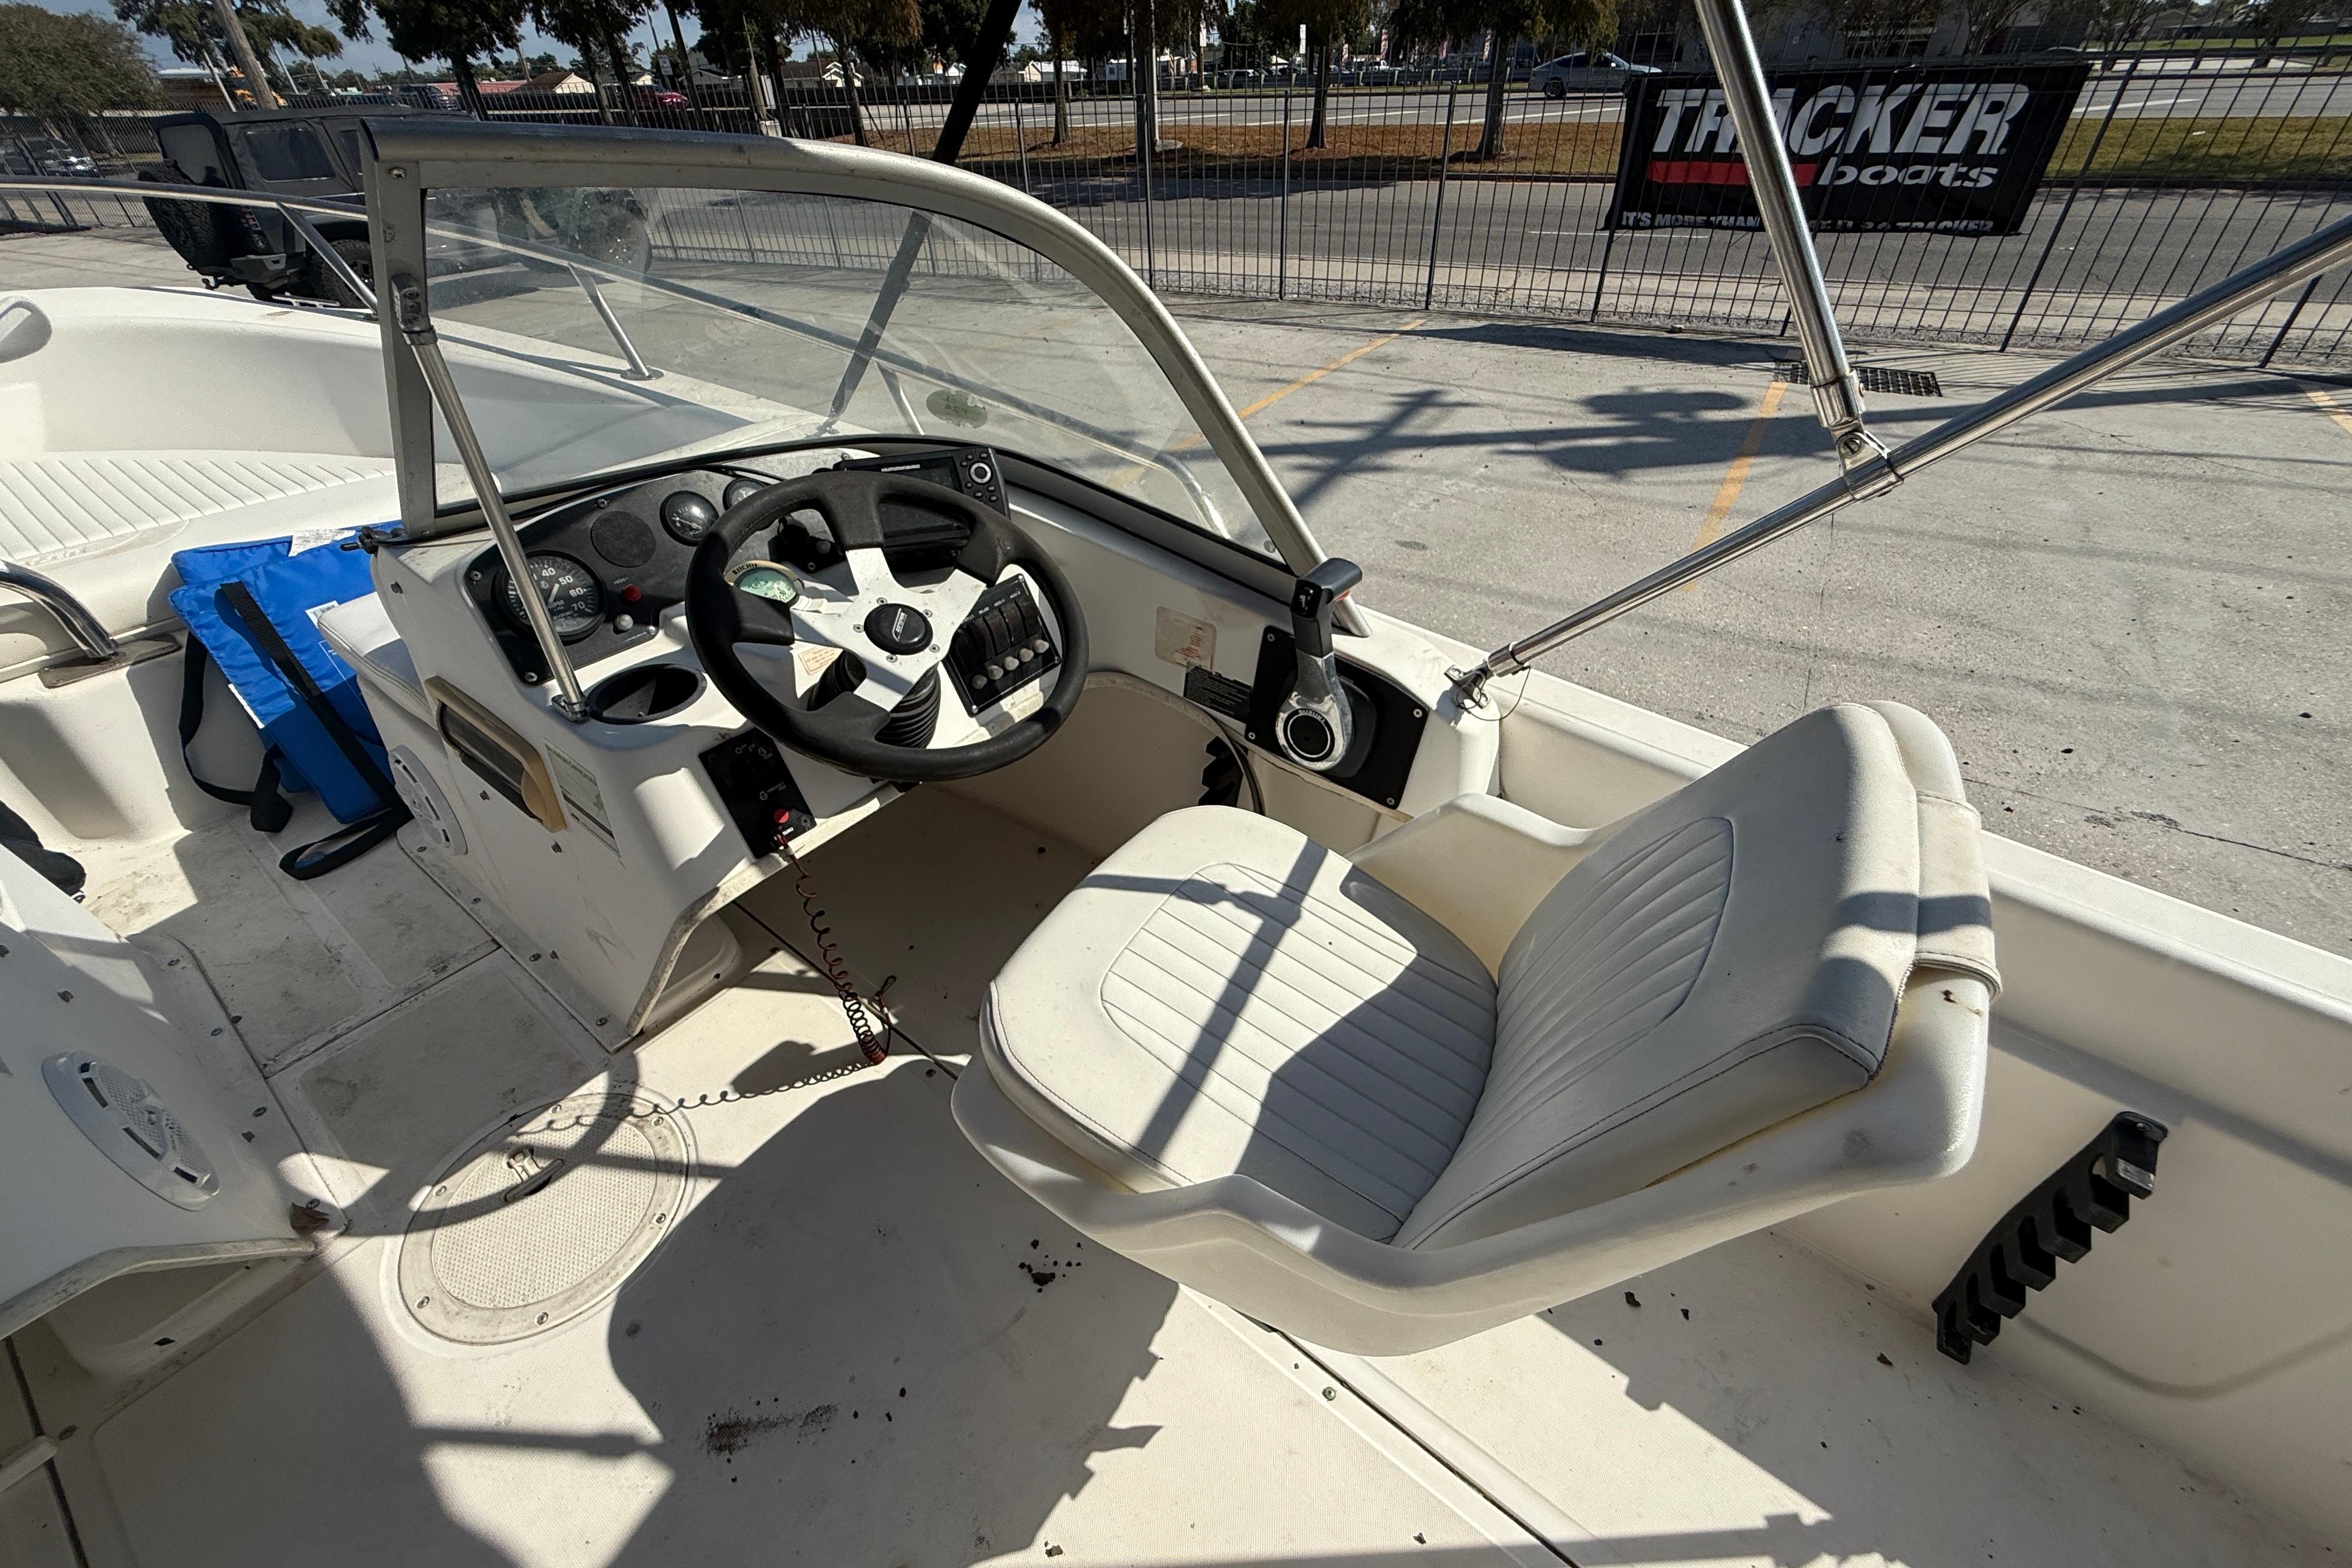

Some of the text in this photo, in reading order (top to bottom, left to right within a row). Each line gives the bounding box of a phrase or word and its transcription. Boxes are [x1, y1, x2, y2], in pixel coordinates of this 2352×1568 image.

[1817, 156, 1999, 188] boats
[1621, 211, 1651, 227] IT'S
[1654, 214, 1707, 227] MORE
[1710, 215, 1760, 228] THAN
[541, 568, 556, 576] 40
[558, 575, 573, 584] 50
[569, 587, 584, 597] 60
[570, 601, 586, 611] 70
